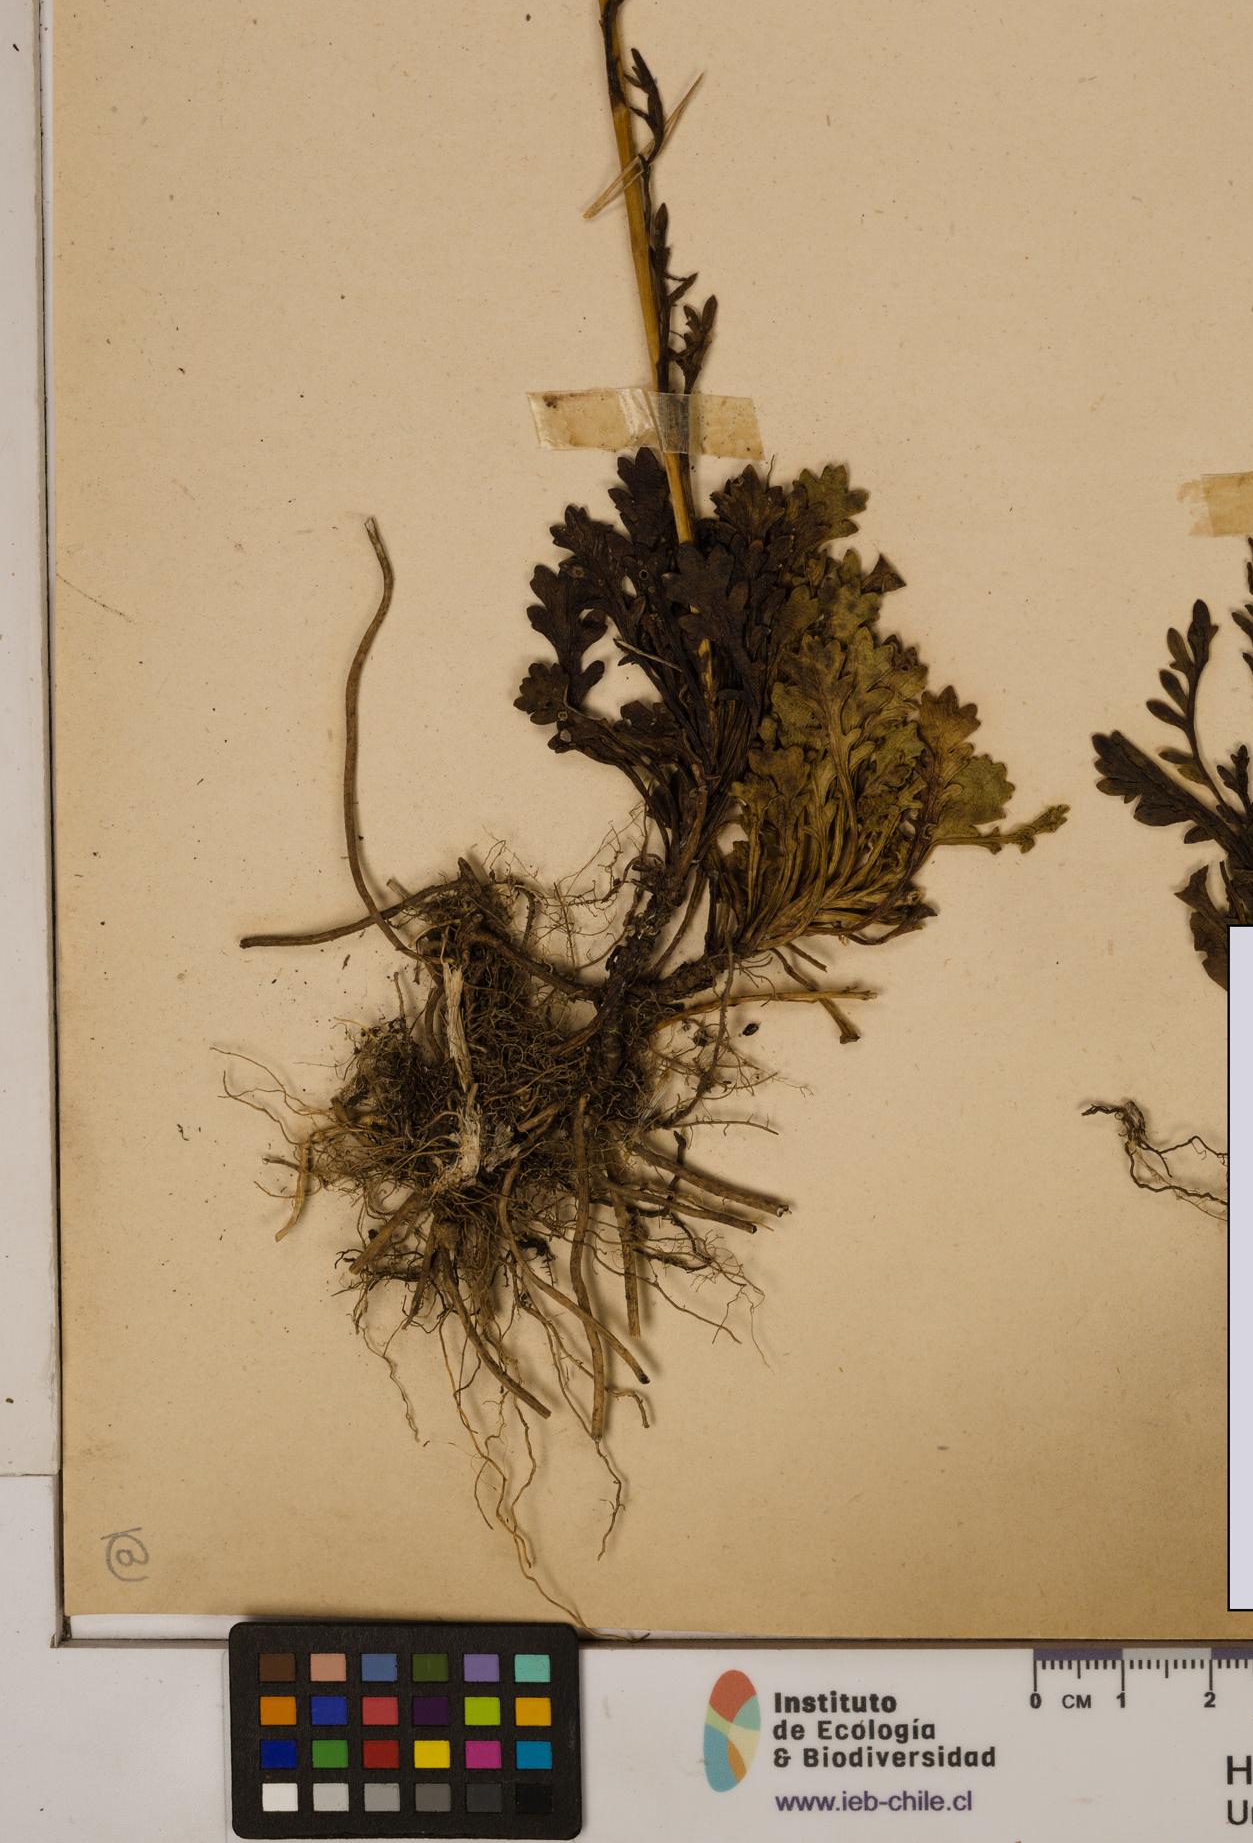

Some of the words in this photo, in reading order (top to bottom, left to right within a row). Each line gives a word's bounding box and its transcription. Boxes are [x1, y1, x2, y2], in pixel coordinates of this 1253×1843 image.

[774, 1690, 898, 1714] Instituto
[1029, 1692, 1042, 1710] 0
[1061, 1694, 1092, 1710] CM
[1116, 1691, 1126, 1709] 1
[1203, 1691, 1216, 1709] 2
[772, 1719, 806, 1741] de
[773, 1747, 792, 1768] &
[803, 1745, 996, 1769] Biodiversidad
[775, 1789, 973, 1812] www.ieb-chile.cl
